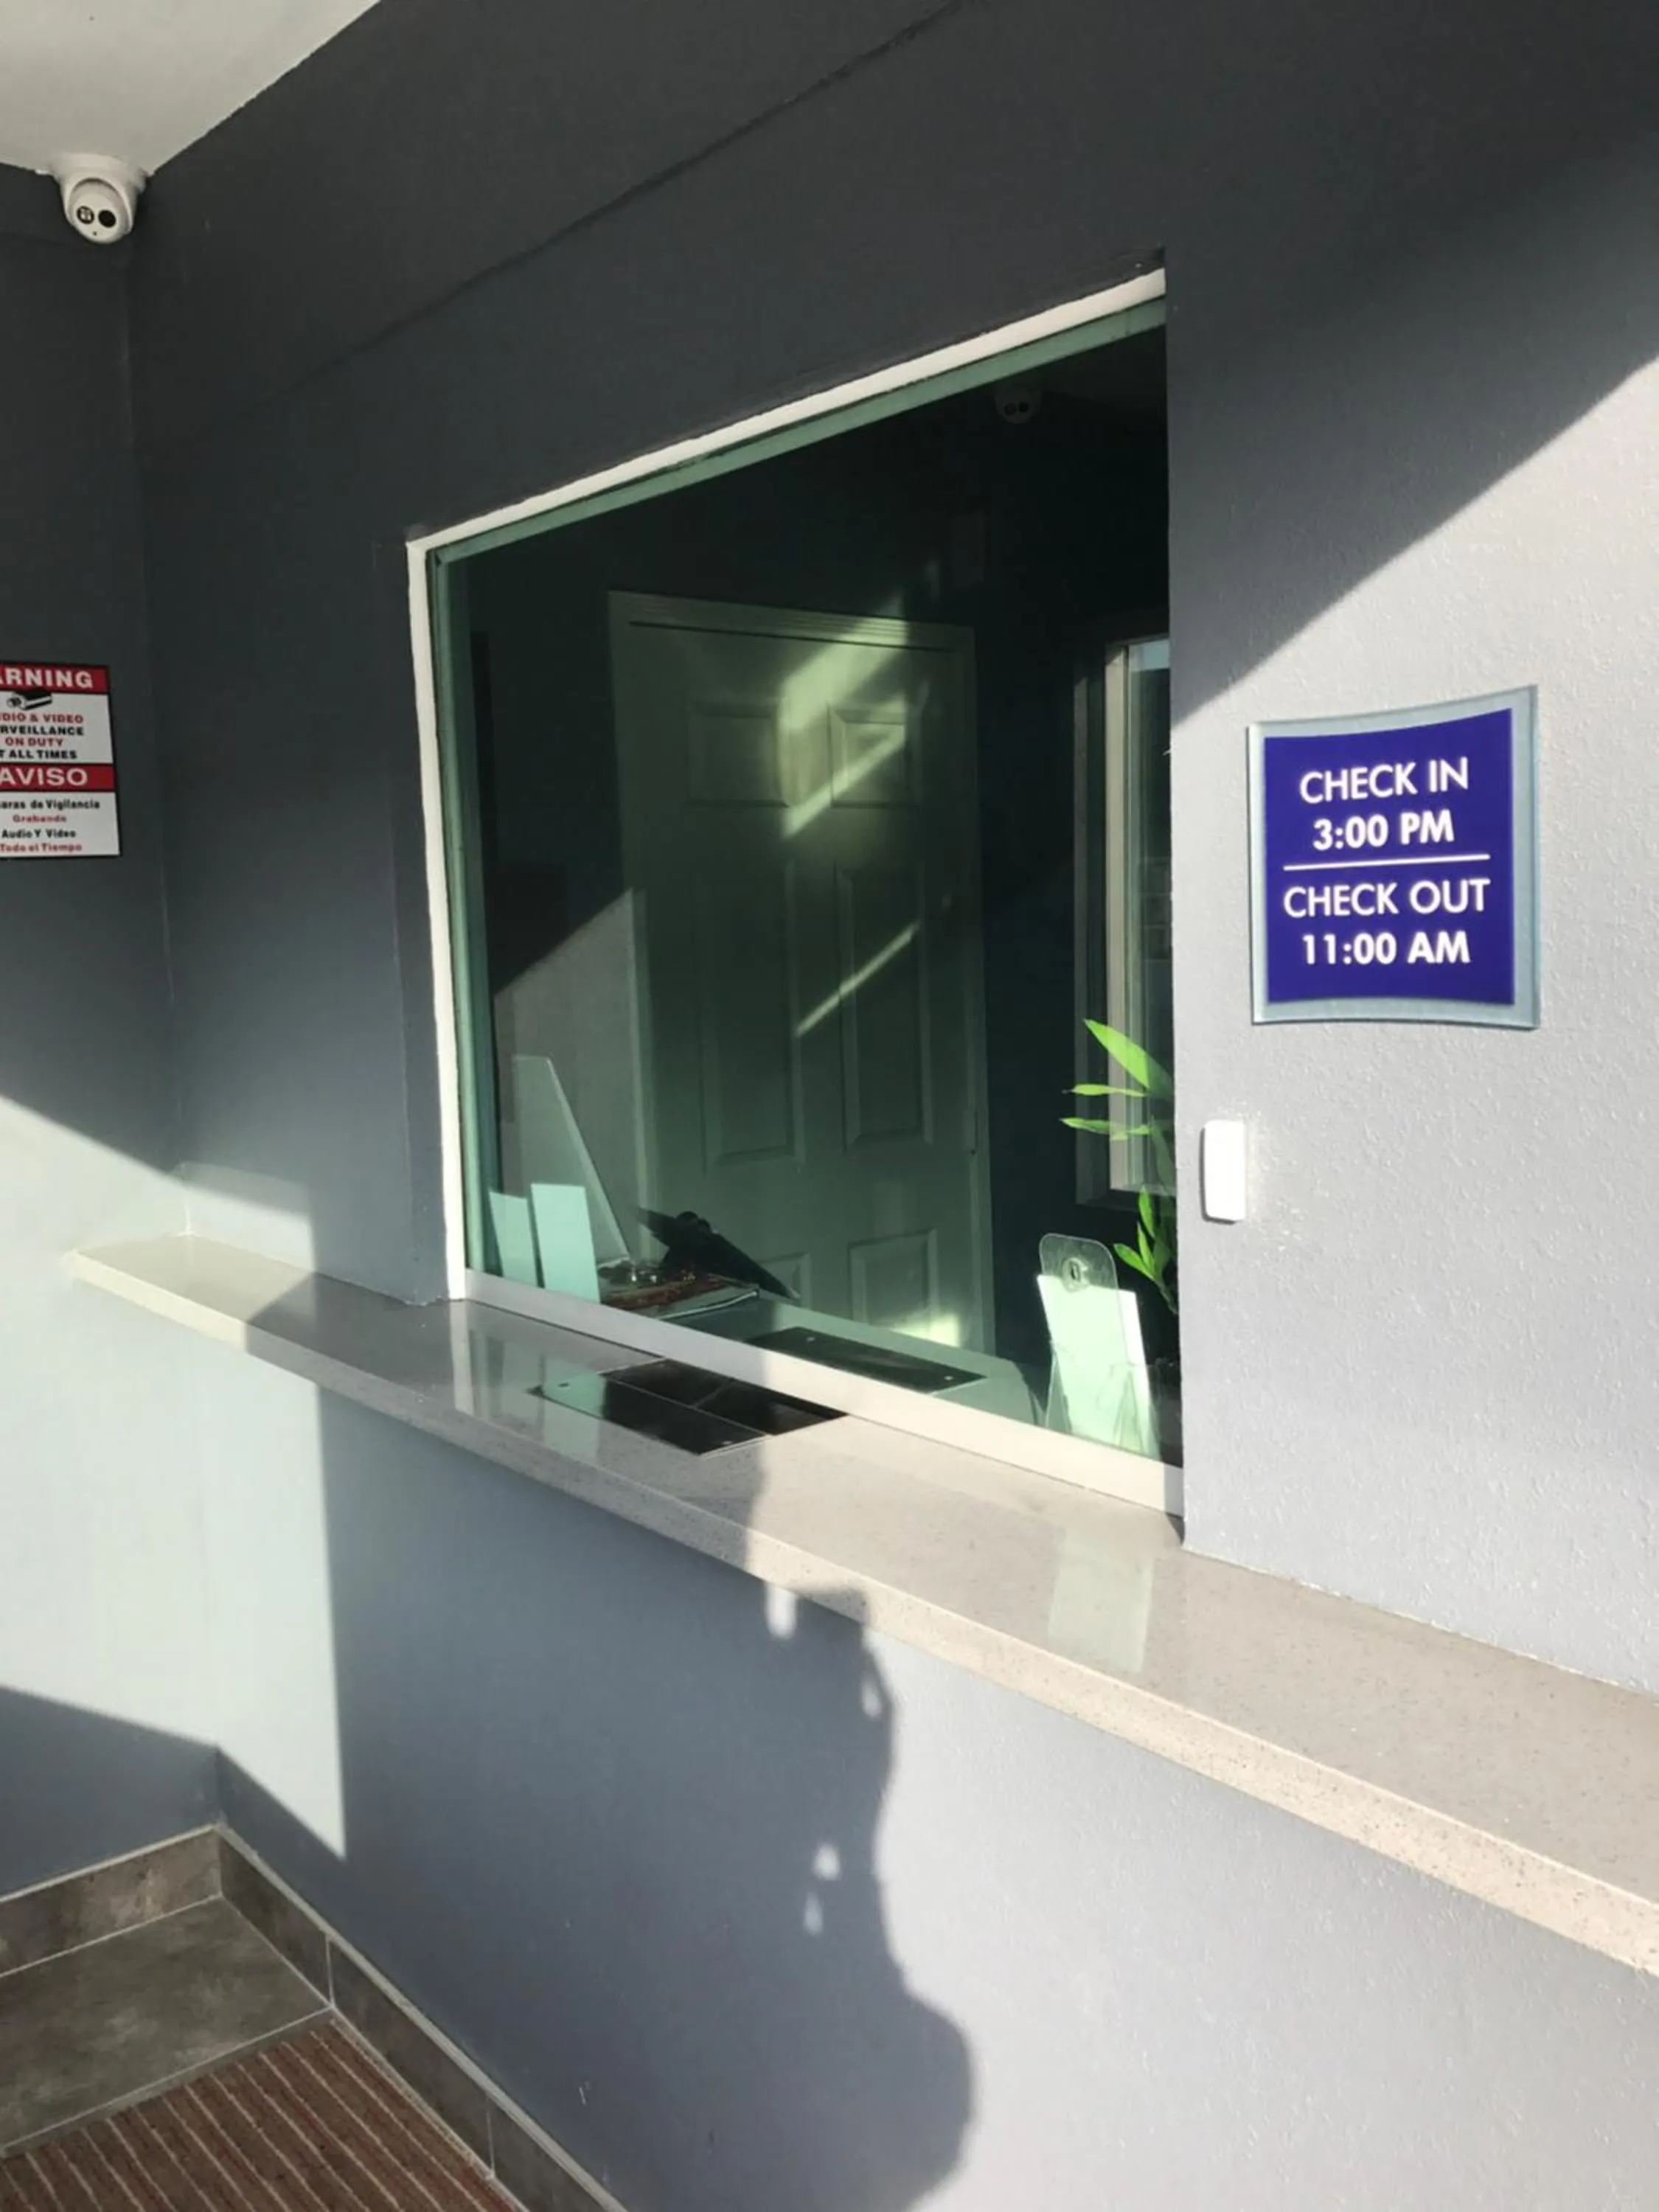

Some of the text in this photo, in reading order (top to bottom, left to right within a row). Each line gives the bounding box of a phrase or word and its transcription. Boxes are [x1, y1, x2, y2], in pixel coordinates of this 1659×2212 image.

[0, 668, 93, 689] RNING
[0, 713, 84, 723] DIO & VIDEO
[4, 737, 63, 747] ON DUTY
[9, 749, 34, 759] ALL
[36, 750, 77, 759] TIMES
[0, 768, 88, 786] AVISO
[1300, 757, 1469, 804] CHECK IN
[0, 799, 100, 811] aras de Vigilancia
[13, 814, 67, 823] Grabando
[1, 828, 77, 838] Audio Y Video
[1312, 810, 1455, 851] 3:00 PM
[0, 843, 83, 852] Todo el Tiempo
[1283, 878, 1492, 918] CHECK OUT
[1302, 931, 1471, 965] 11:00 AM
